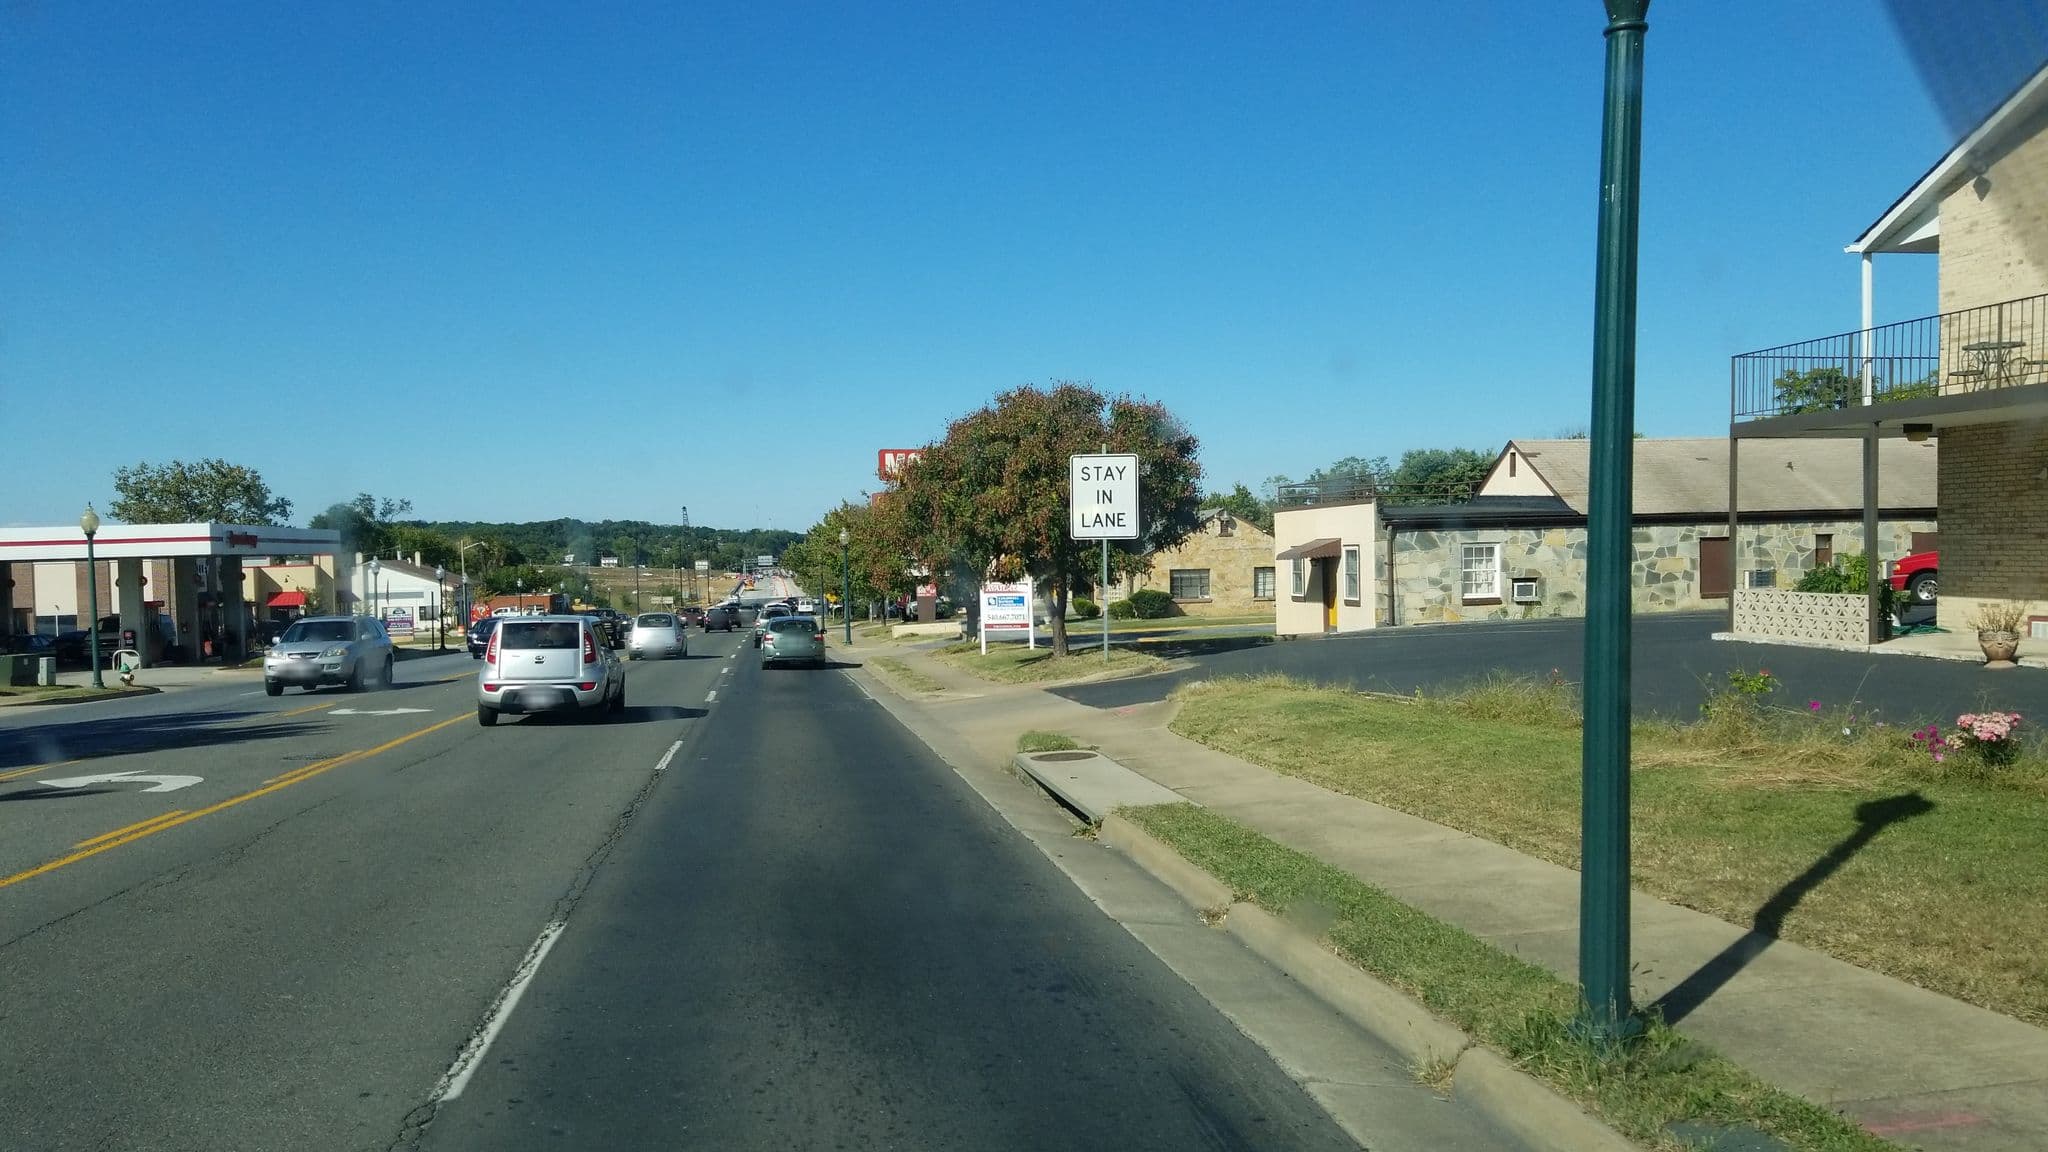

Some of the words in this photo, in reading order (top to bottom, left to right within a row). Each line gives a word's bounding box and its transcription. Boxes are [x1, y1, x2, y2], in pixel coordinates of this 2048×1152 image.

[1081, 466, 1127, 481] STAY
[1096, 489, 1113, 504] IN
[1081, 512, 1127, 528] LANE
